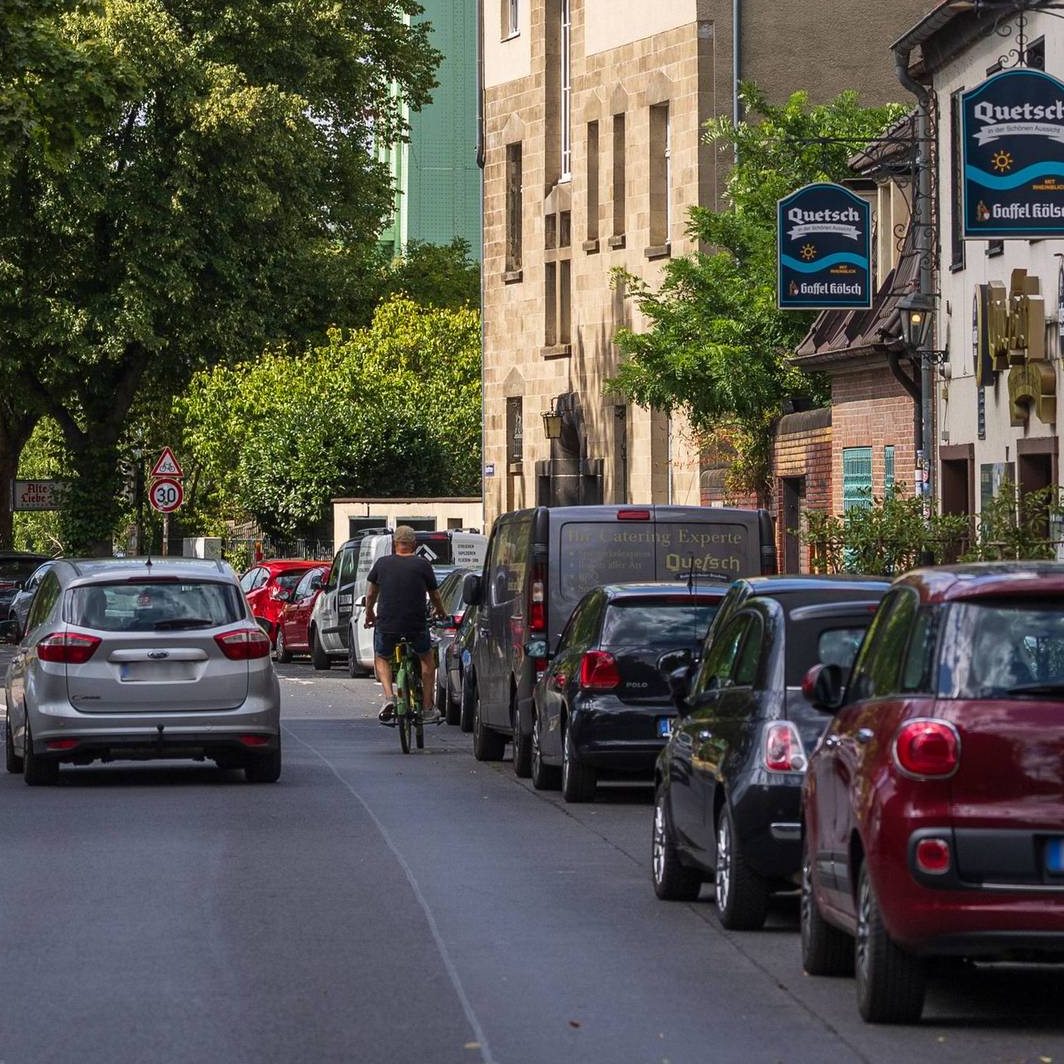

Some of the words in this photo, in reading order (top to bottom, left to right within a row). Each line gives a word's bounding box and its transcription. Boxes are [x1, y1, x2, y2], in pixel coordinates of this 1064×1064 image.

[788, 207, 860, 224] Quetsch
[992, 203, 1031, 220] Gaffel
[801, 282, 829, 295] Gaffel
[830, 282, 861, 296] Kölsch
[27, 483, 49, 493] Alte
[157, 488, 176, 503] 30
[599, 529, 671, 546] Catering
[679, 528, 742, 547] Experte
[666, 553, 740, 572] Quetsch
